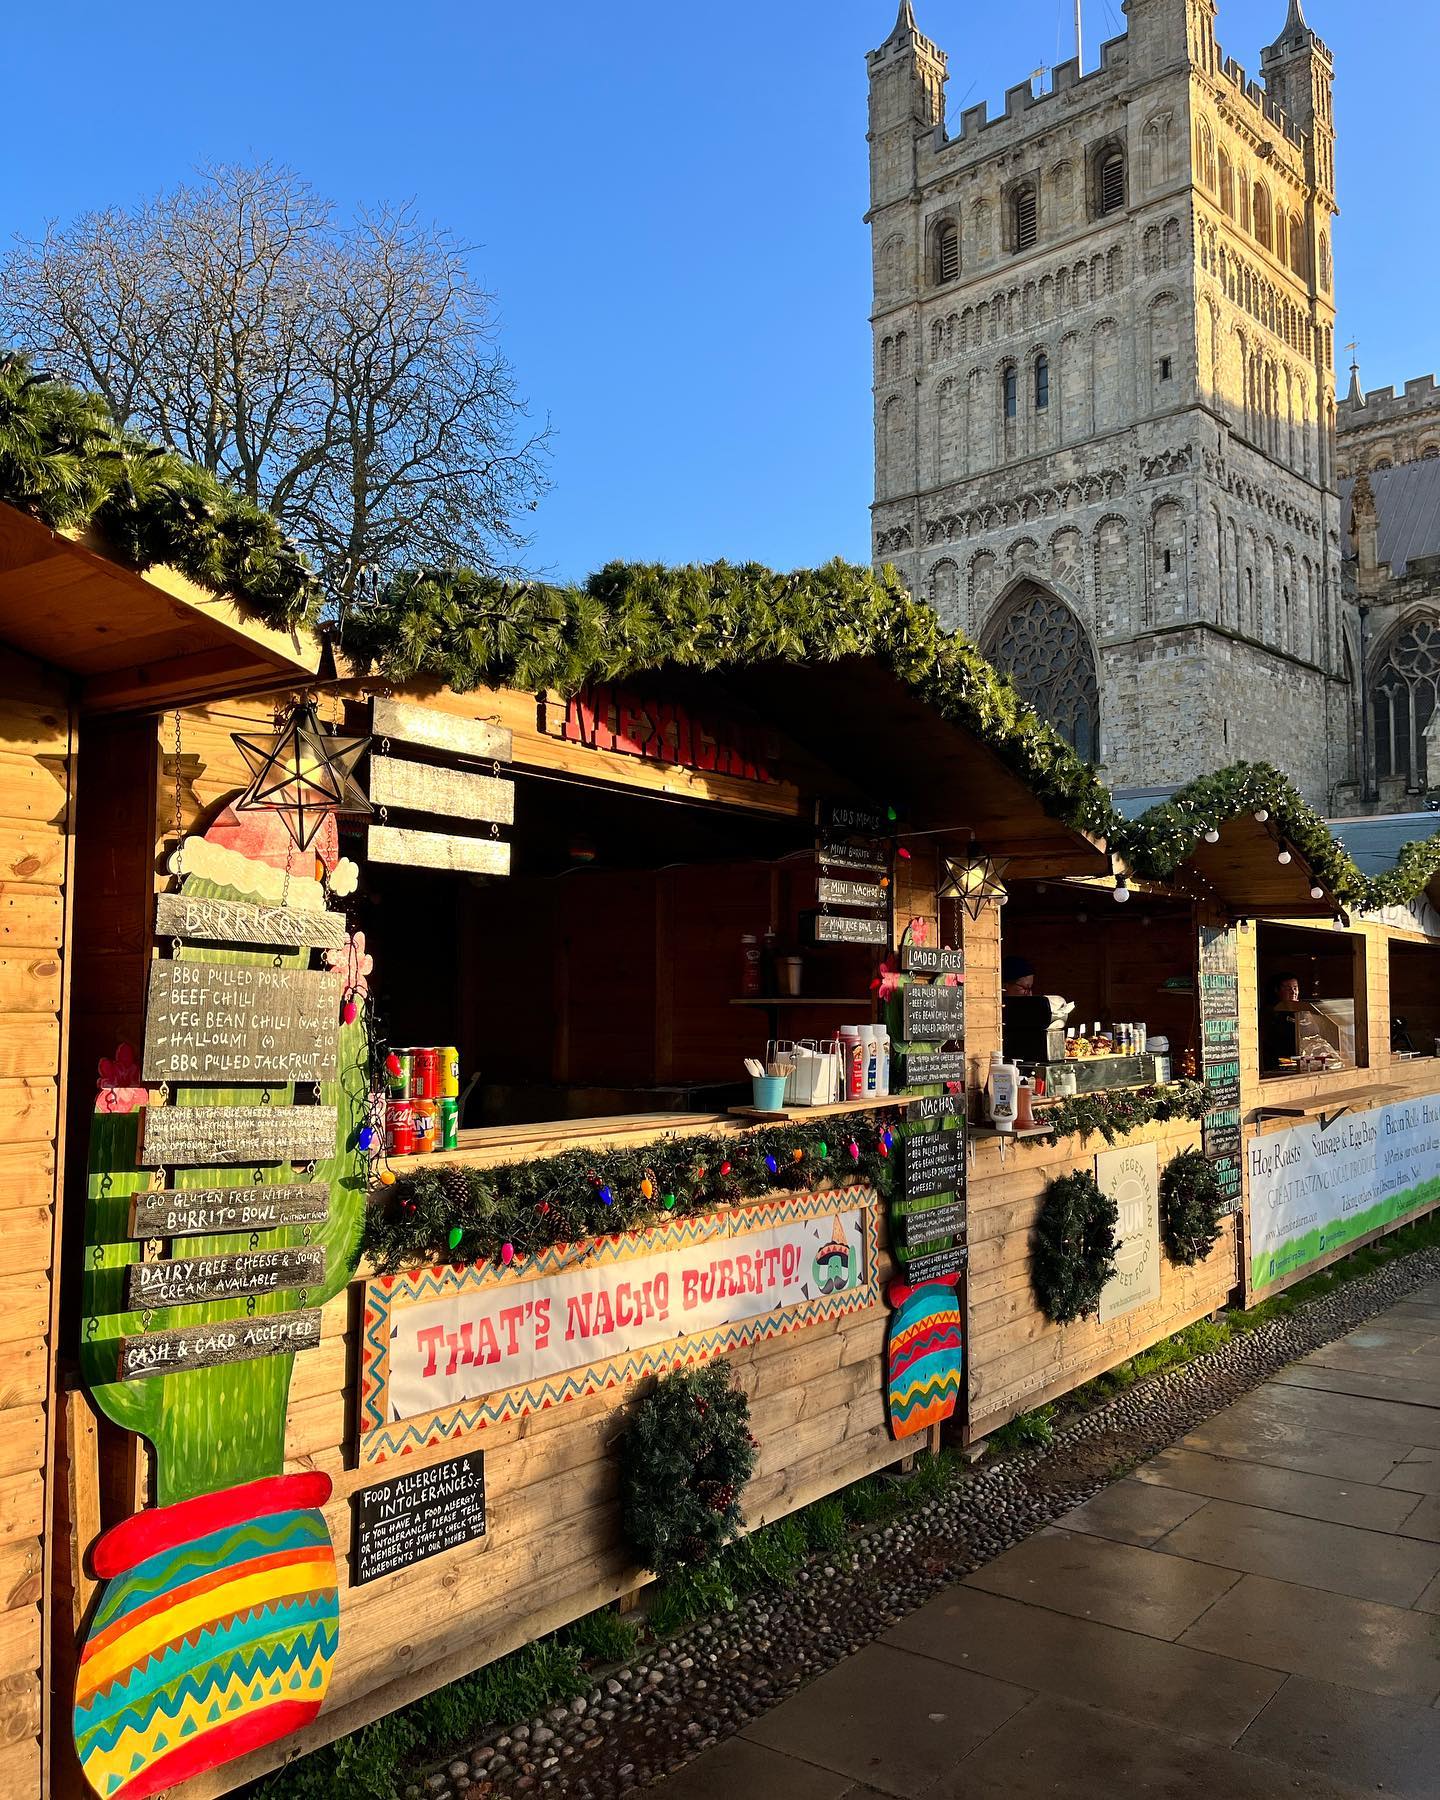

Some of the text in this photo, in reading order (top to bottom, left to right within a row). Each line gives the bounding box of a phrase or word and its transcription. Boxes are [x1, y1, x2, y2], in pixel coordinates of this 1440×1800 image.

[830, 844, 847, 855] MINI
[830, 882, 848, 894] MINI
[853, 884, 877, 898] NACHOS
[186, 903, 305, 936] BURRITOS
[830, 919, 845, 932] MINI
[909, 949, 961, 968] LOADED FRIES
[173, 966, 337, 990] BBQ PULLED PORK £10
[171, 988, 334, 1008] BEEF CHILLI £9
[912, 999, 922, 1008] BEEF
[170, 1012, 200, 1027] VEG
[206, 1012, 245, 1028] BEAN
[252, 1015, 290, 1029] CHILLI
[322, 1018, 335, 1030] £9
[170, 1032, 247, 1048] HALLOUMI
[315, 1036, 334, 1047] £10
[170, 1052, 337, 1071] BBQ PULLED JACKFRUIT £9
[920, 1096, 955, 1117] NACHOS
[214, 1138, 233, 1149] HOT
[912, 1135, 925, 1147] BEEF
[1251, 1147, 1272, 1177] Hog
[1273, 1143, 1301, 1170] Roasts
[1311, 1133, 1340, 1158] Sausage
[1349, 1124, 1362, 1151] Egg
[1385, 1114, 1404, 1135] Bacon
[146, 1188, 304, 1209] GO GLUTEN FREE WITH A
[912, 1181, 935, 1195] CHEESEY
[1119, 1157, 1153, 1228] VEGETARIAN
[1267, 1181, 1293, 1209] GREAT
[1294, 1171, 1330, 1199] TASTING
[167, 1207, 236, 1229] BURRITO
[241, 1205, 276, 1223] BOWL
[141, 1252, 321, 1286] DAIRY FREE CHEESE & SOUR
[1135, 1239, 1150, 1281] FOOD
[160, 1273, 278, 1299] CREAM AVAILABLE
[417, 1242, 802, 1379] THAT'S NACHO BURRITO!
[128, 1322, 312, 1368] CASH & CARD ACCEPTED
[364, 1459, 471, 1508] FOOD ALLERGIES &
[380, 1473, 474, 1518] INTOLERANCES
[361, 1502, 480, 1554] OR INTOLERANCE PLEASE TELL
[362, 1492, 476, 1543] IF YOU HAVE A FOOD ALLERGY
[361, 1511, 482, 1569] A MEMBER OF STAFF & CHECK THE
[362, 1531, 466, 1579] INGREDIENTS IN OUR DISHES
